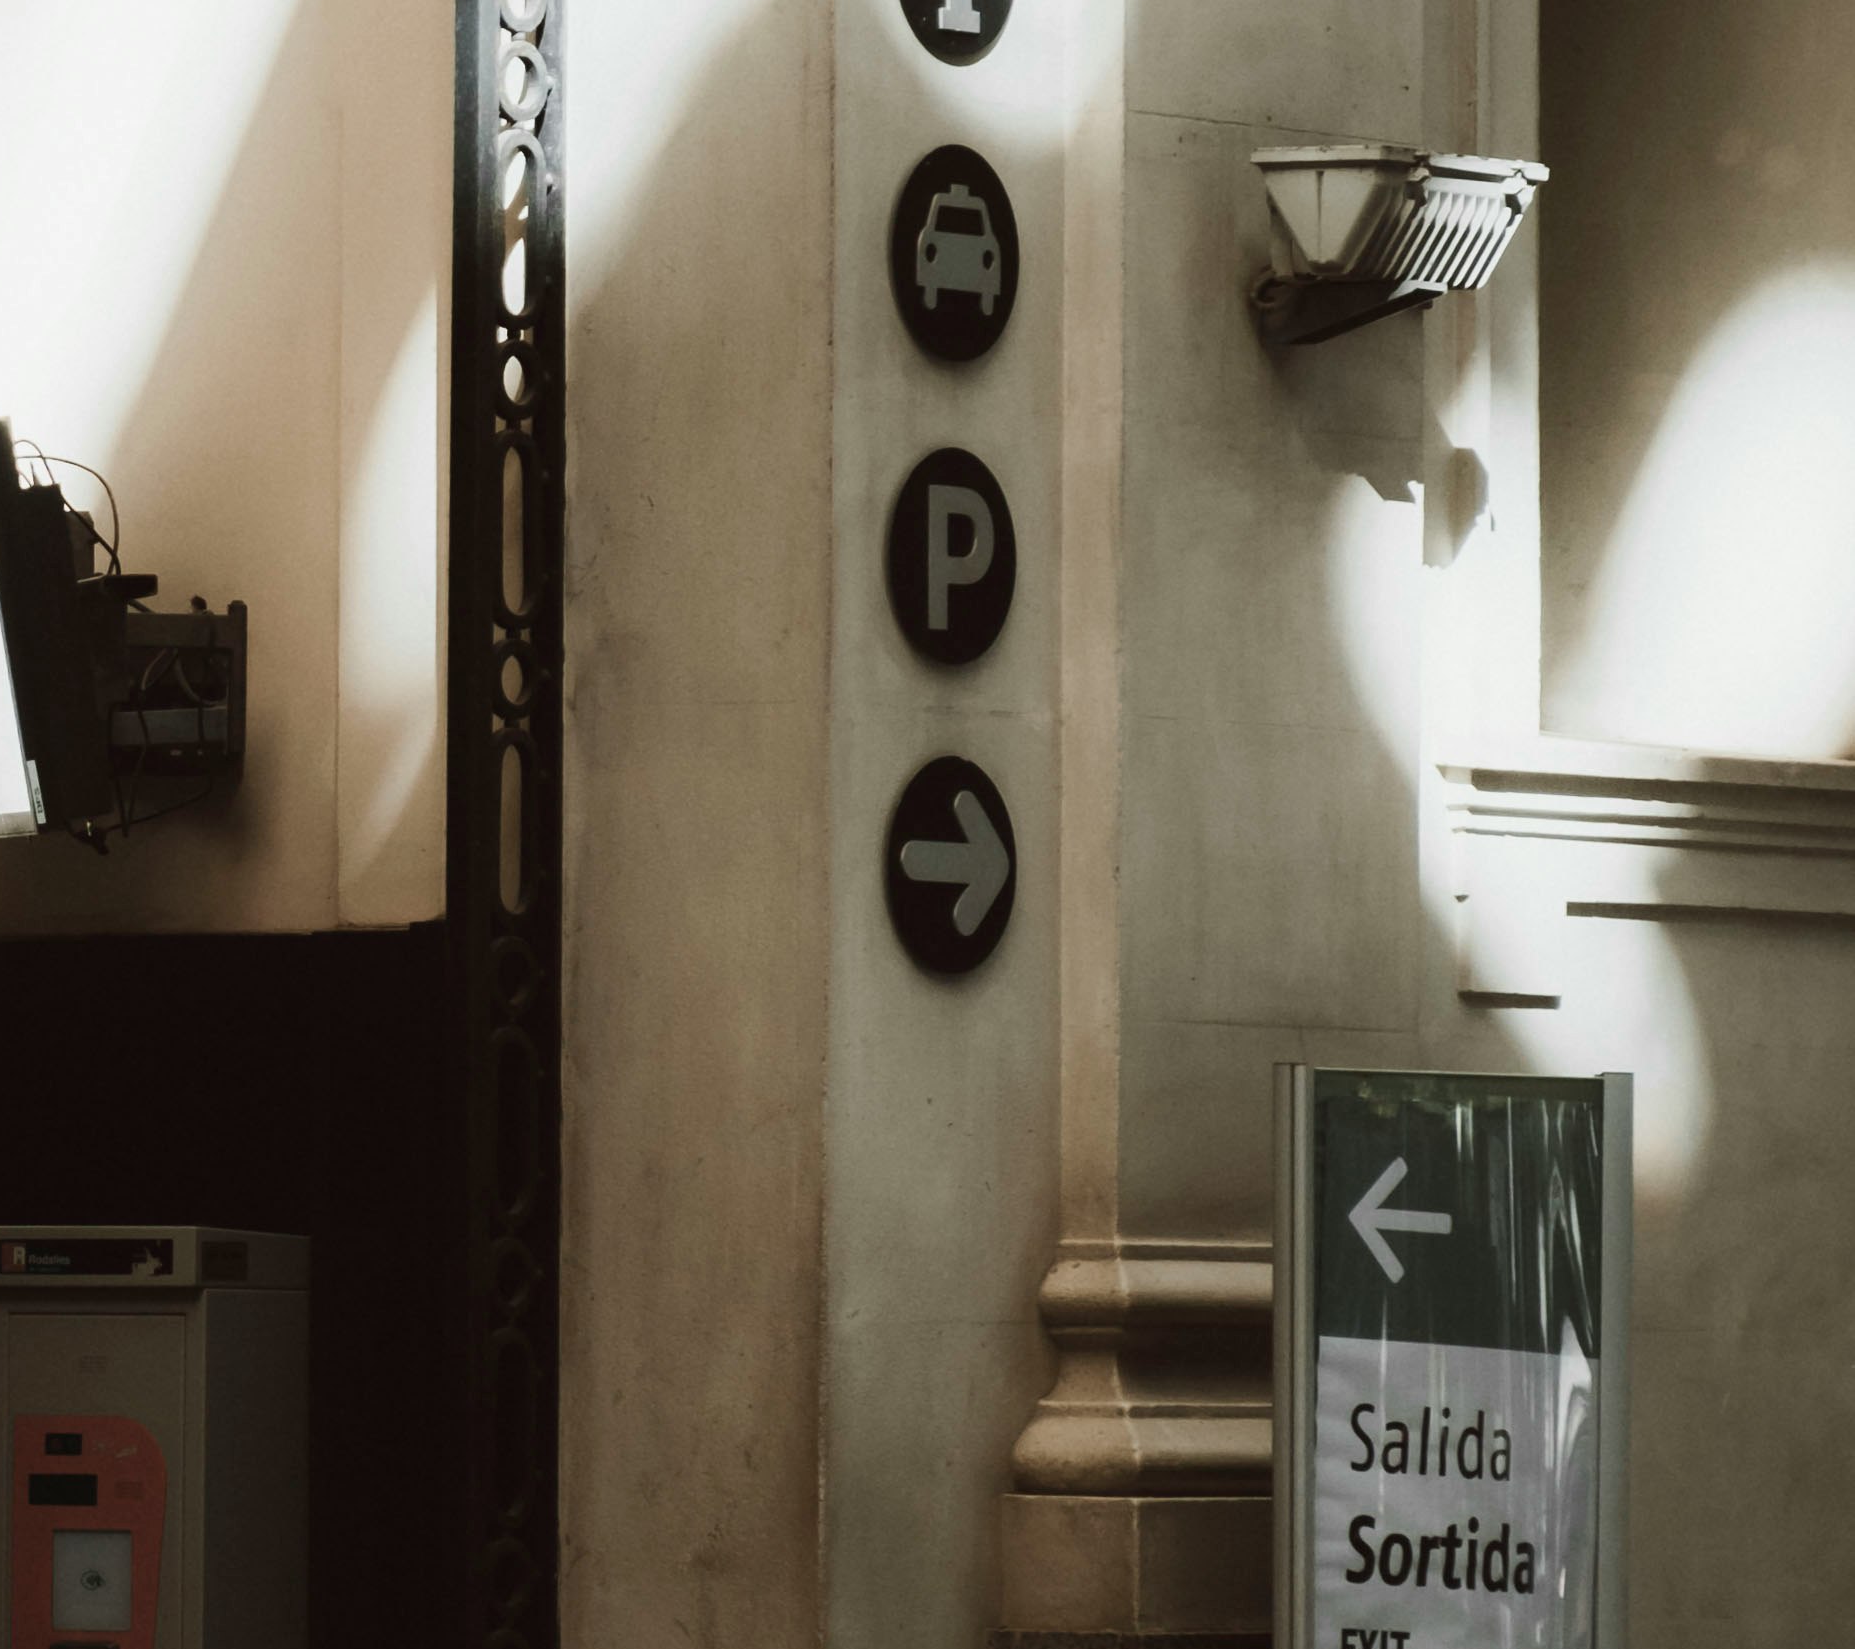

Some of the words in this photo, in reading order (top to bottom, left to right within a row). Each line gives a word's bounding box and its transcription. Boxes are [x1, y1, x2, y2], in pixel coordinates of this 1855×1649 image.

[928, 483, 995, 630] P
[1349, 1402, 1512, 1482] Salida
[1345, 1514, 1536, 1595] Sortida
